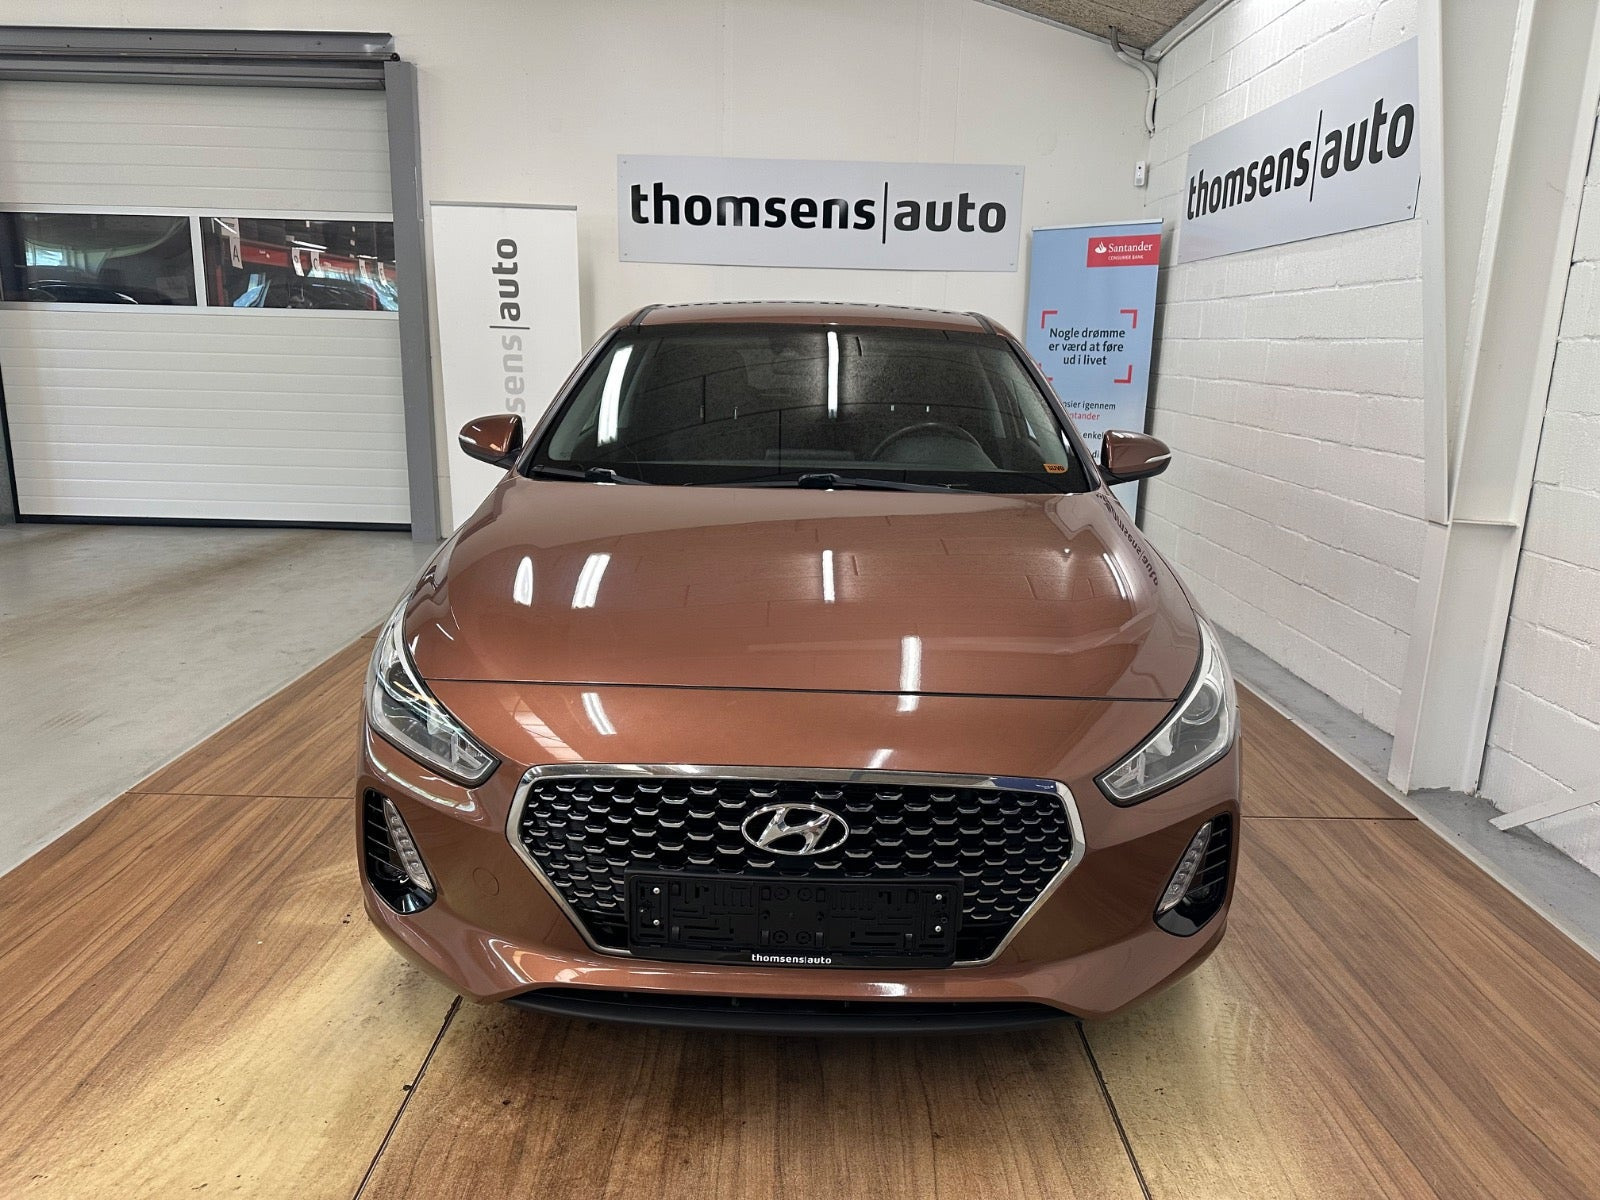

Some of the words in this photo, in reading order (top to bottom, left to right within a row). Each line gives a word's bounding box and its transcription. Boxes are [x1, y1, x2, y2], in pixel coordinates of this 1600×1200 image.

[1108, 240, 1153, 253] Santander
[489, 238, 531, 420] sens|auto
[1049, 327, 1080, 341] Nogle
[1081, 327, 1126, 339] drømme
[1048, 343, 1059, 352] er
[1062, 341, 1087, 352] værd
[1089, 342, 1100, 352] at
[1102, 340, 1124, 353] føre
[1063, 354, 1076, 365] ud
[1083, 354, 1107, 365] livet
[1063, 400, 1080, 408] nsier
[1082, 401, 1116, 411] igennem
[1070, 412, 1100, 421] ntander
[1083, 431, 1104, 440] enkel
